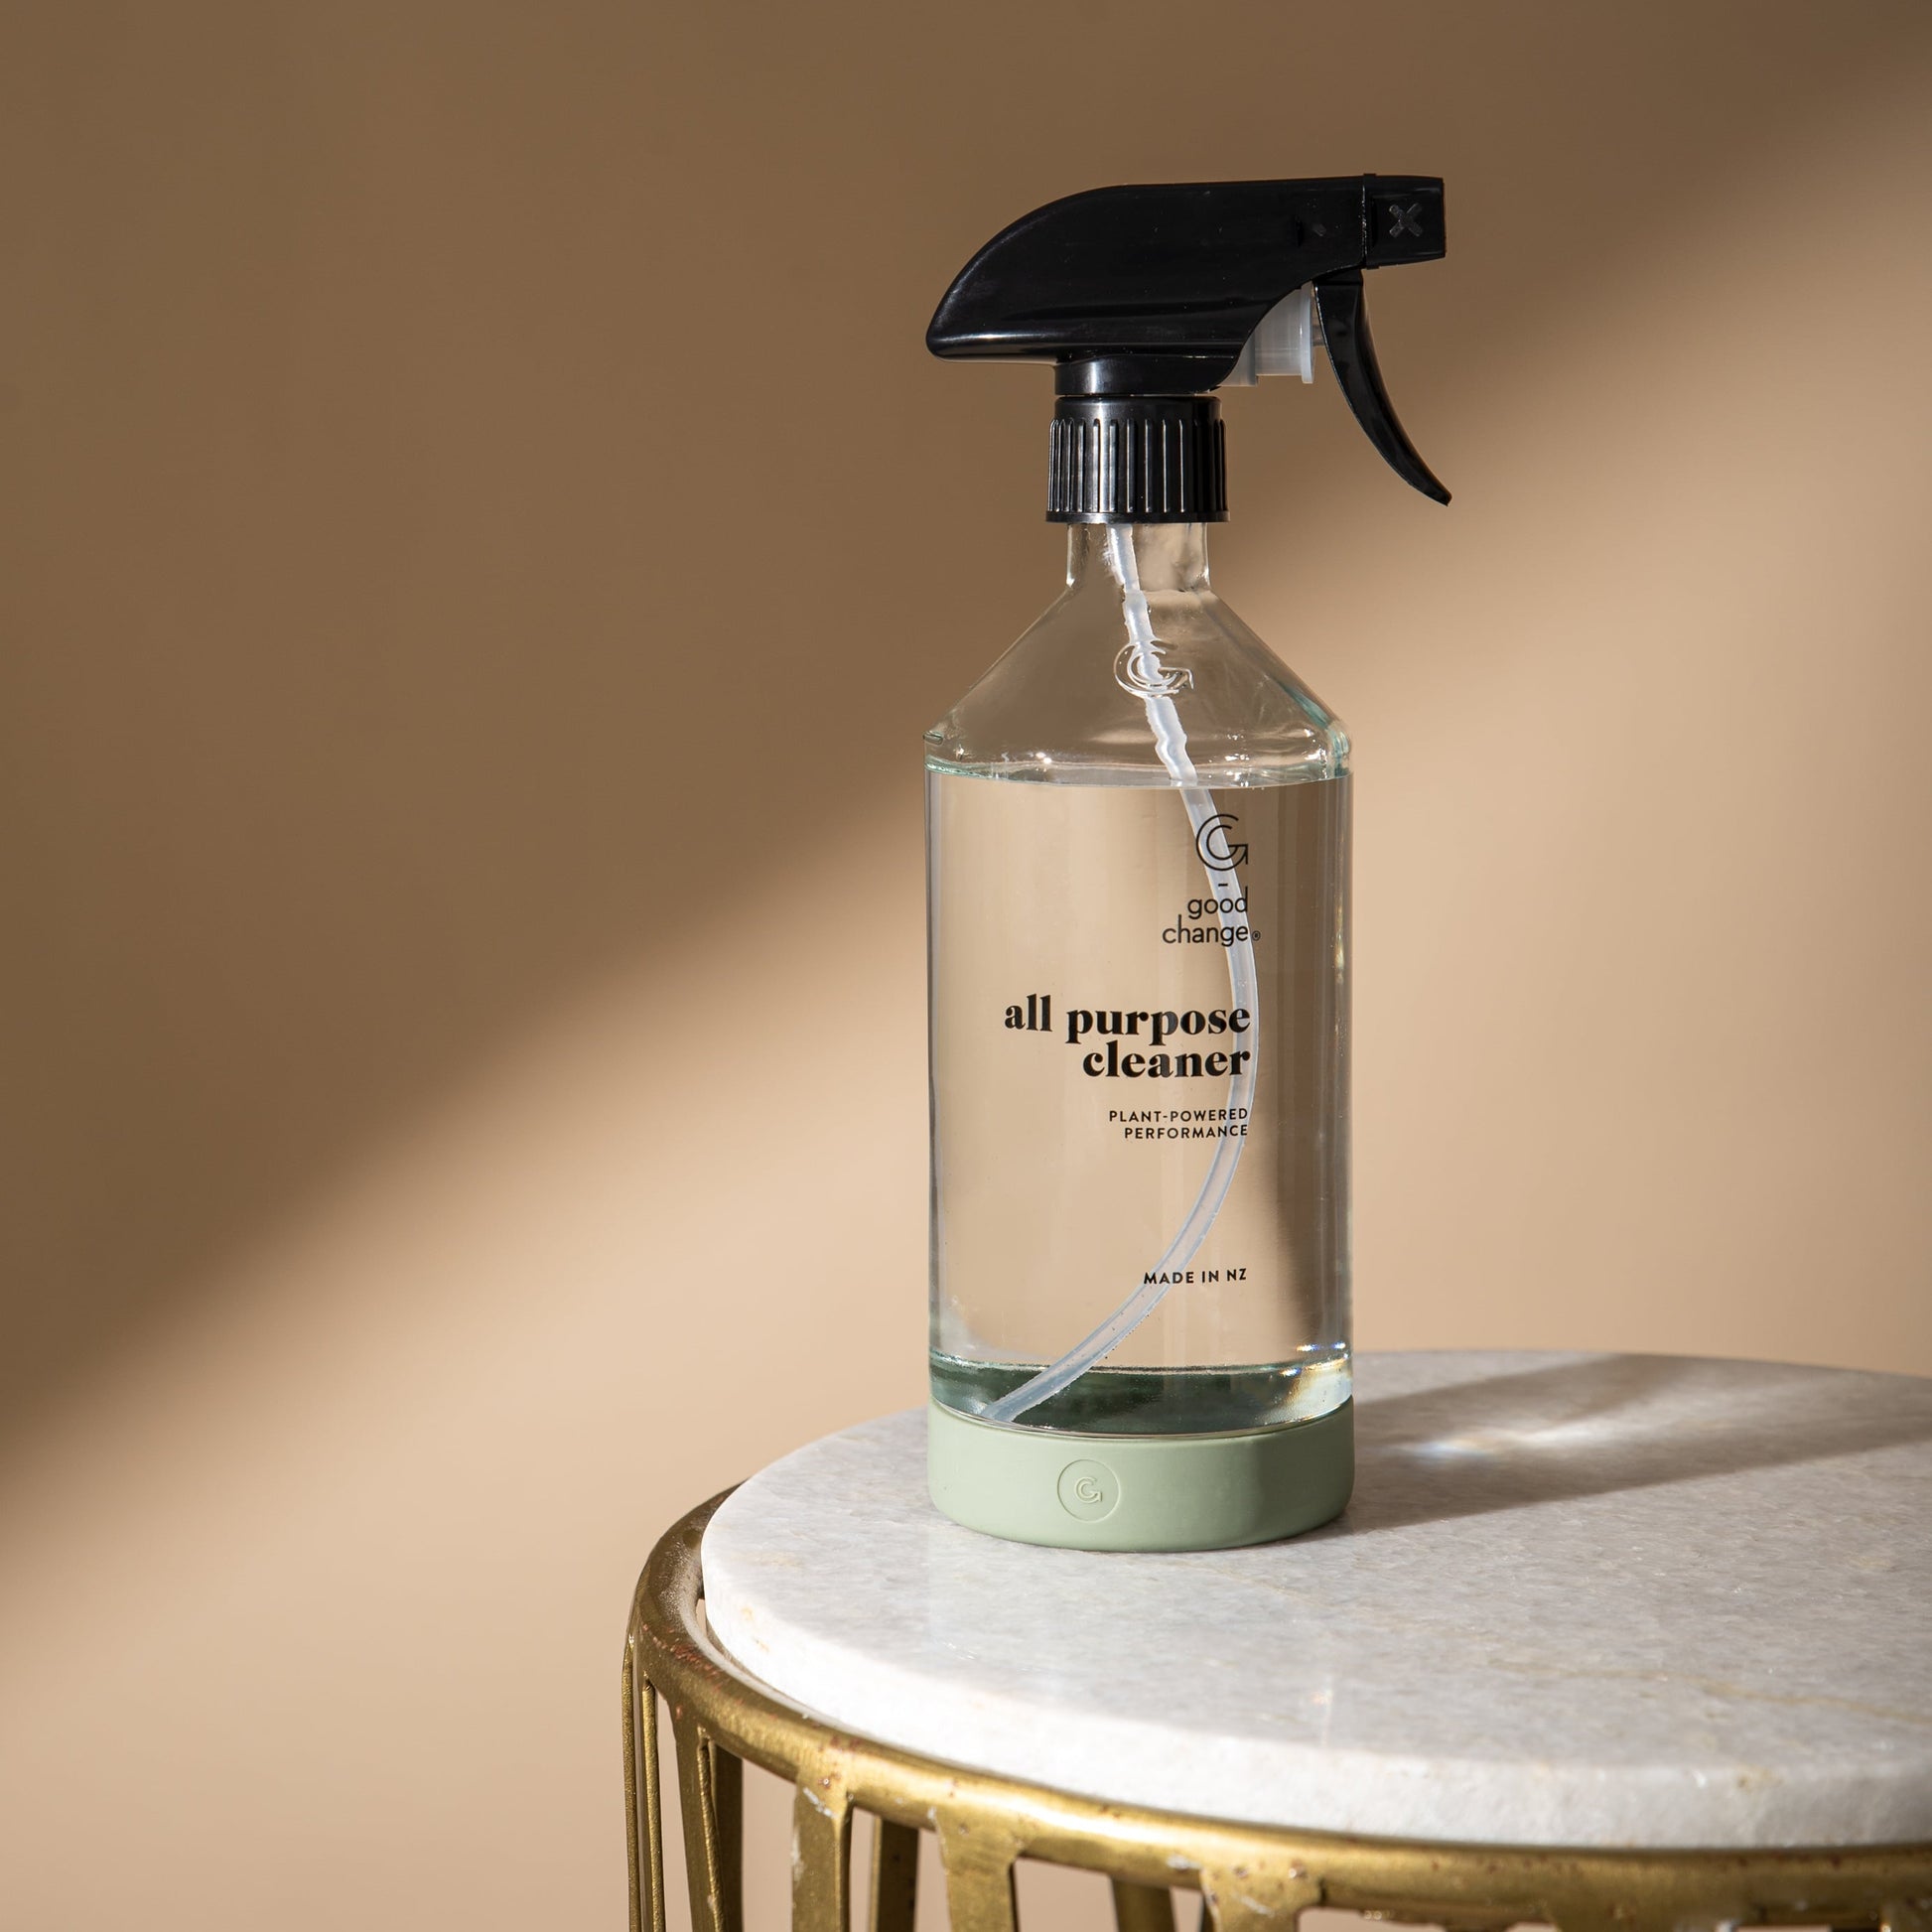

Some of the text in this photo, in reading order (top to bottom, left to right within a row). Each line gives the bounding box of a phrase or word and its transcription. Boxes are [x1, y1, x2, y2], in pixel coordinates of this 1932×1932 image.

[1186, 886, 1249, 920] good
[1004, 993, 1251, 1046] all purpose
[1082, 1039, 1251, 1079] cleaner
[1108, 1108, 1249, 1123] PLANT-POWERED
[1124, 1124, 1249, 1140] PERFORMANCE
[1143, 1268, 1248, 1285] MADE IN NZ
